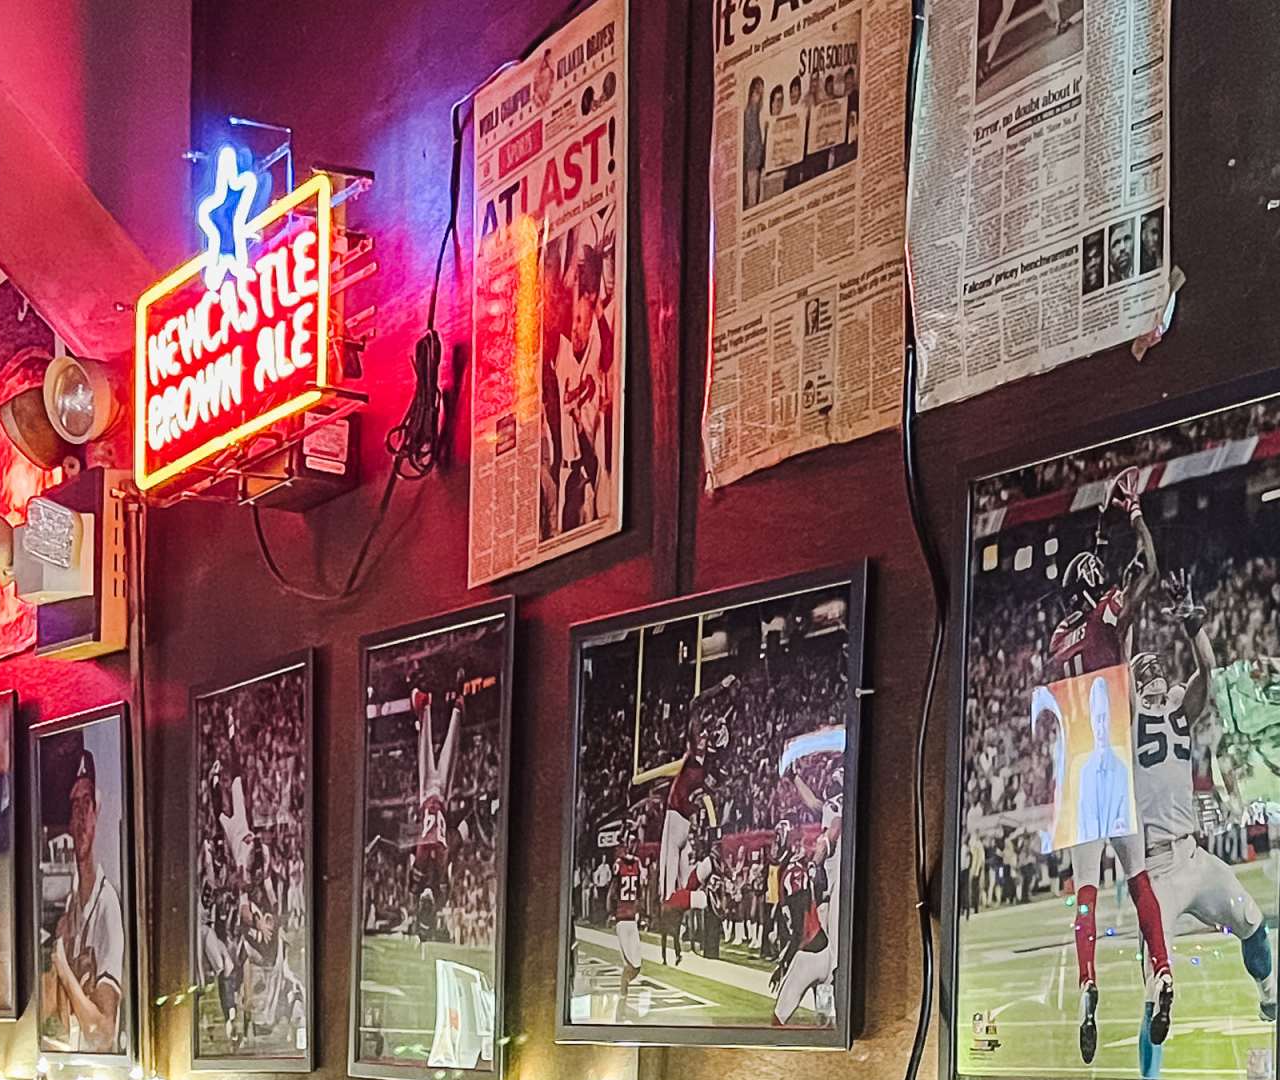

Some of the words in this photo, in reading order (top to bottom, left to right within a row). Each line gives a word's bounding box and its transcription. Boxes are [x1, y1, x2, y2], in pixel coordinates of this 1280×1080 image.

[148, 231, 319, 386] NEWCASTLE
[148, 345, 243, 451] BROWN
[253, 301, 314, 392] ALE
[620, 875, 638, 901] 25
